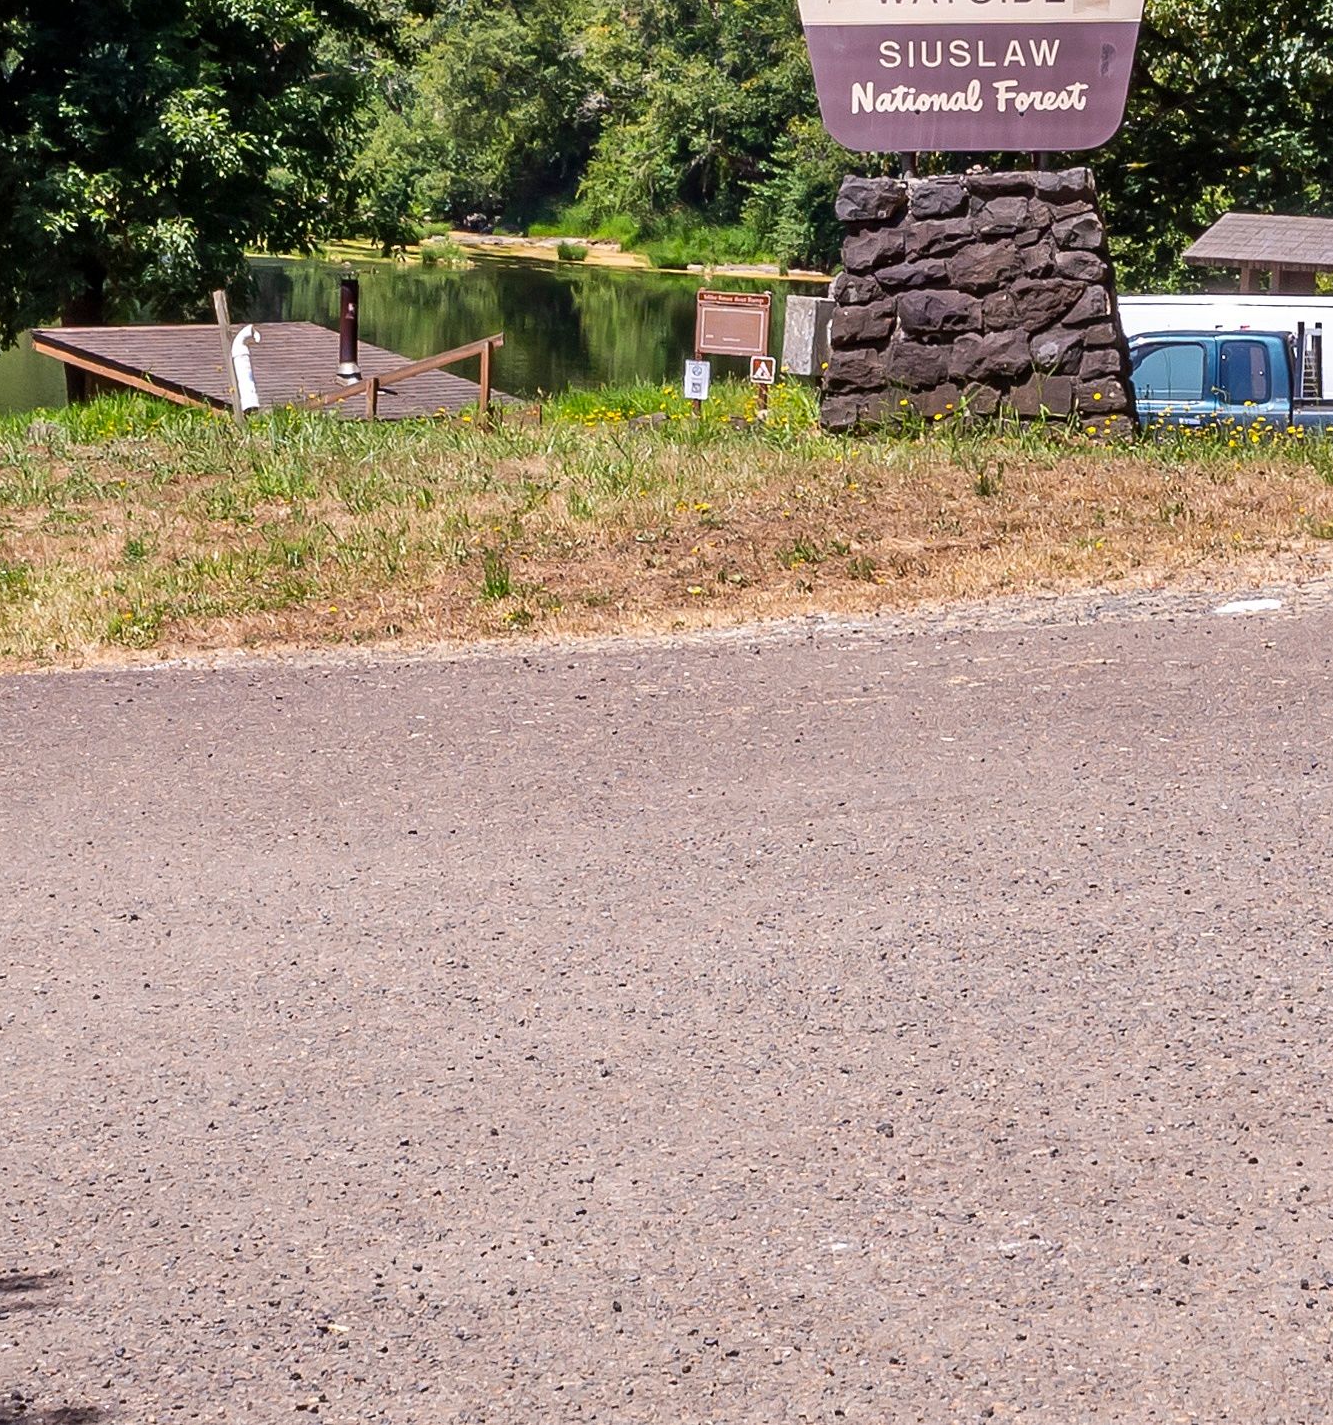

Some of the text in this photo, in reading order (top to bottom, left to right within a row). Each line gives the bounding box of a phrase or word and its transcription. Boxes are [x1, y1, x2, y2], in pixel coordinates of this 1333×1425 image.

[879, 39, 1060, 68] SIUSLAW
[851, 79, 1089, 114] National Forest
